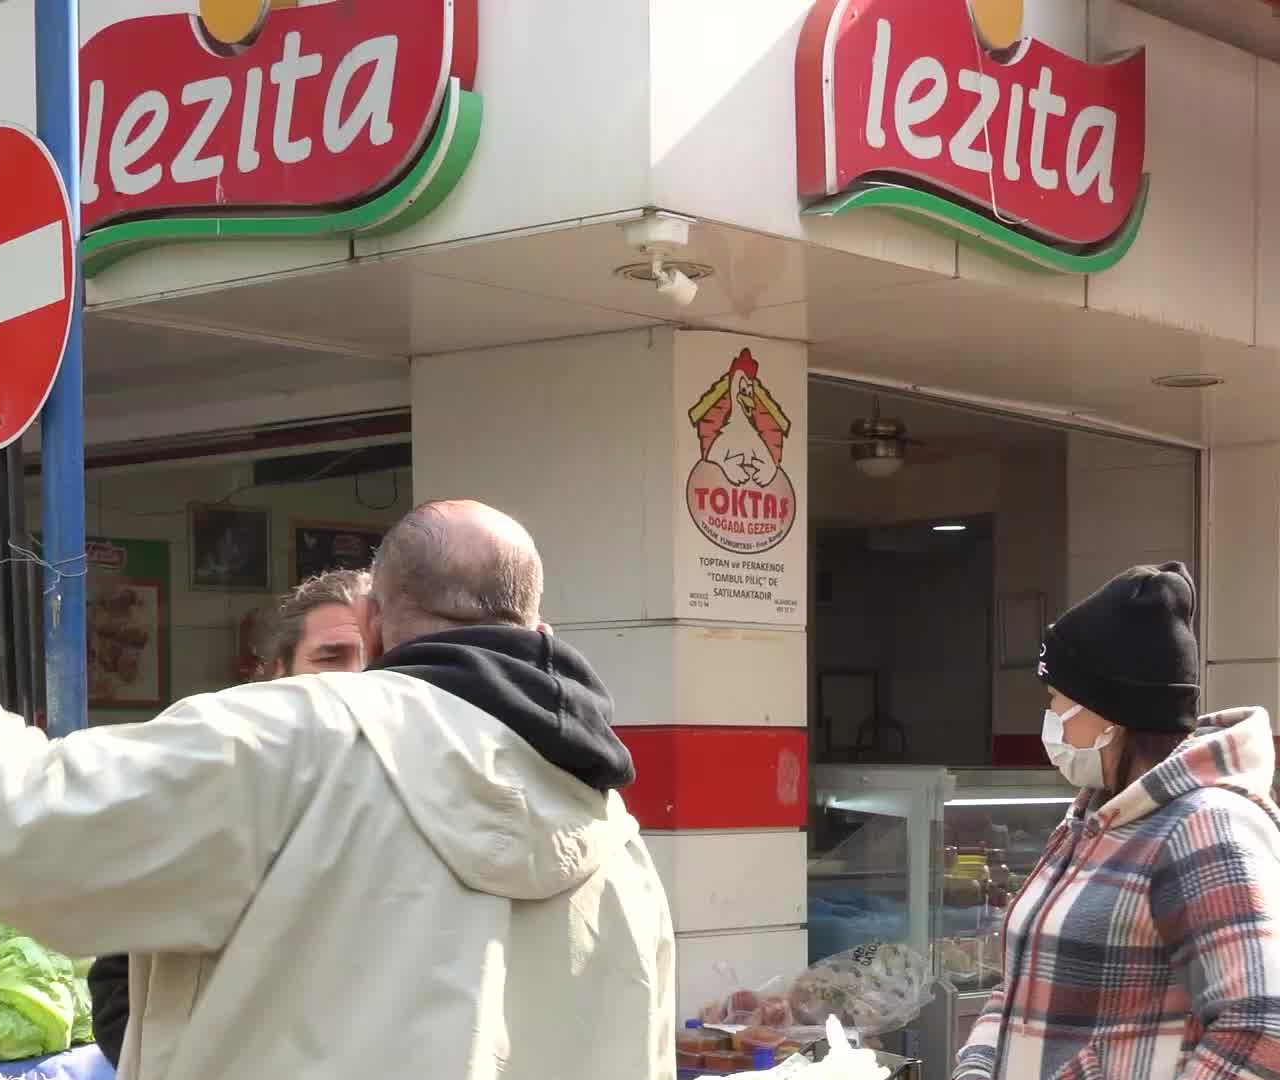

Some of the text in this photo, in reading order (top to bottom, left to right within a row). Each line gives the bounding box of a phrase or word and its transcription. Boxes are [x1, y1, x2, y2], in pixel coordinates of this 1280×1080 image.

[694, 487, 789, 523] TOKTAŞ
[699, 557, 730, 569] TOPTAN
[742, 560, 785, 573] PERAKENDE
[768, 577, 778, 587] DE
